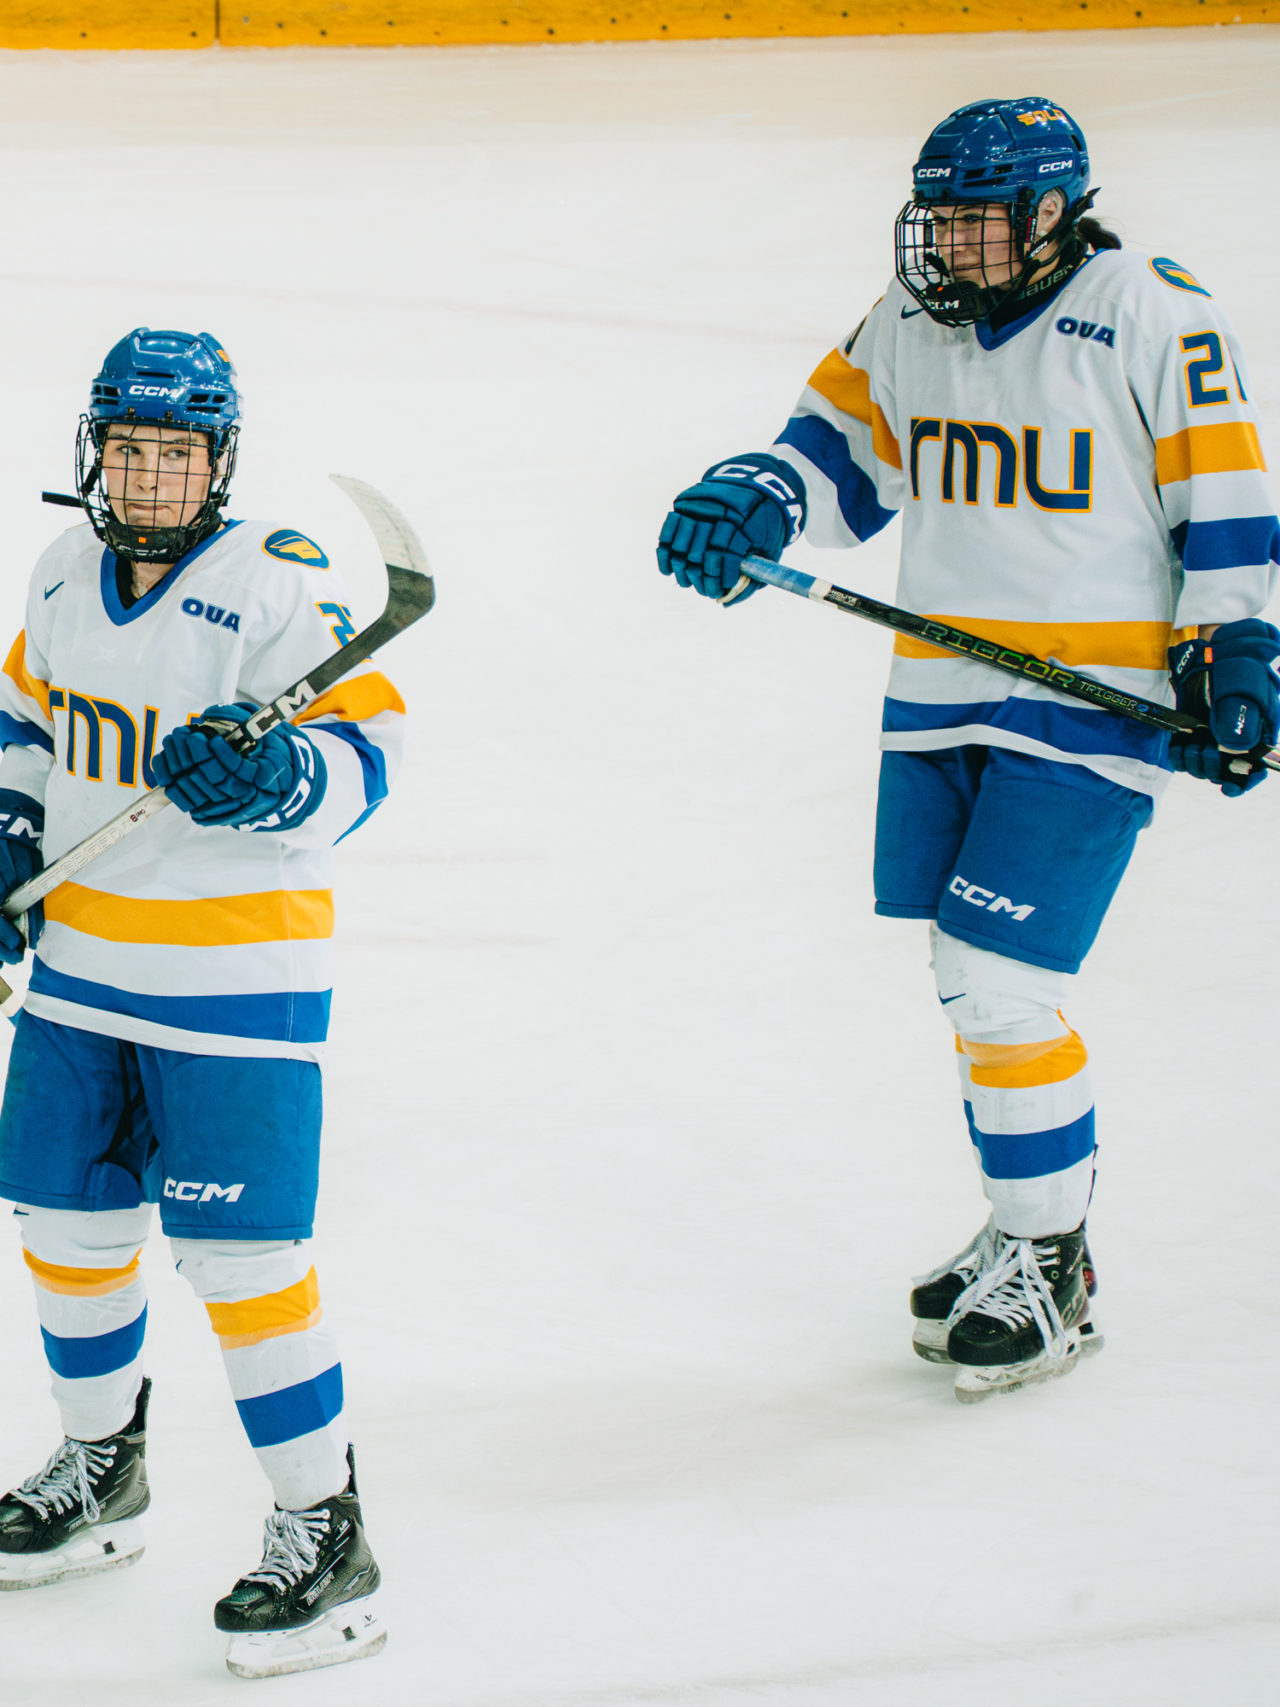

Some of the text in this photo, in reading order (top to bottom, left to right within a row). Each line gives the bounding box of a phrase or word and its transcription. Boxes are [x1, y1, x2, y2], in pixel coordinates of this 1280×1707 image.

[917, 167, 952, 179] CCM
[1038, 159, 1074, 174] CCM
[1054, 315, 1116, 350] OUA
[1178, 329, 1248, 409] 2
[128, 384, 182, 398] CCM
[712, 463, 803, 544] CCM
[180, 596, 241, 635] OUA
[920, 620, 1077, 688] RIBCOR
[1079, 680, 1138, 711] TRIGGER
[1176, 643, 1195, 675] CCM
[1234, 704, 1248, 736] CCM
[237, 734, 316, 833] CCM
[948, 875, 1037, 922] CCM
[163, 1176, 246, 1204] CCM
